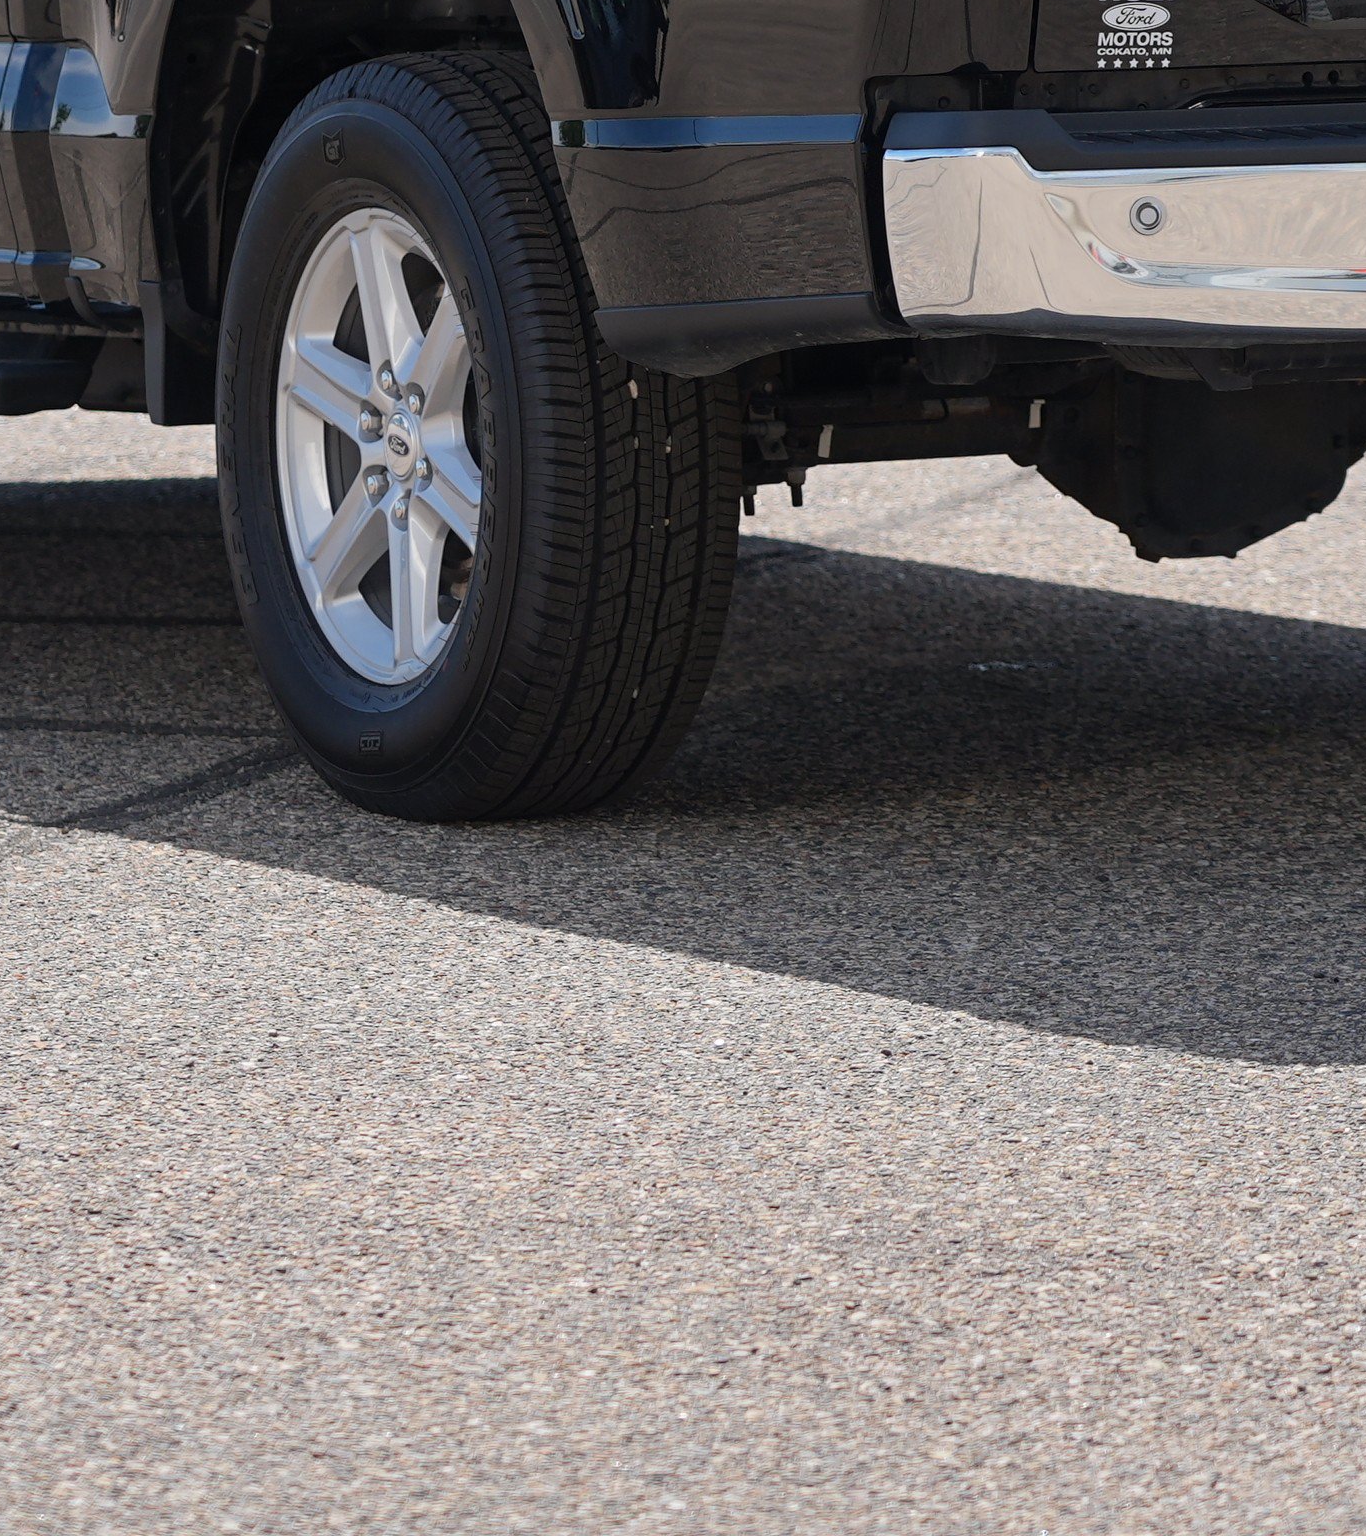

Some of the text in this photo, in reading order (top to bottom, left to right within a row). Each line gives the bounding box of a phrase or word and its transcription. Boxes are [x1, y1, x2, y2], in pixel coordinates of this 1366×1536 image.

[1116, 7, 1156, 24] Ford
[1097, 32, 1173, 46] MOTORS
[1097, 48, 1149, 56] COKATO,
[220, 324, 259, 607] GENERAL
